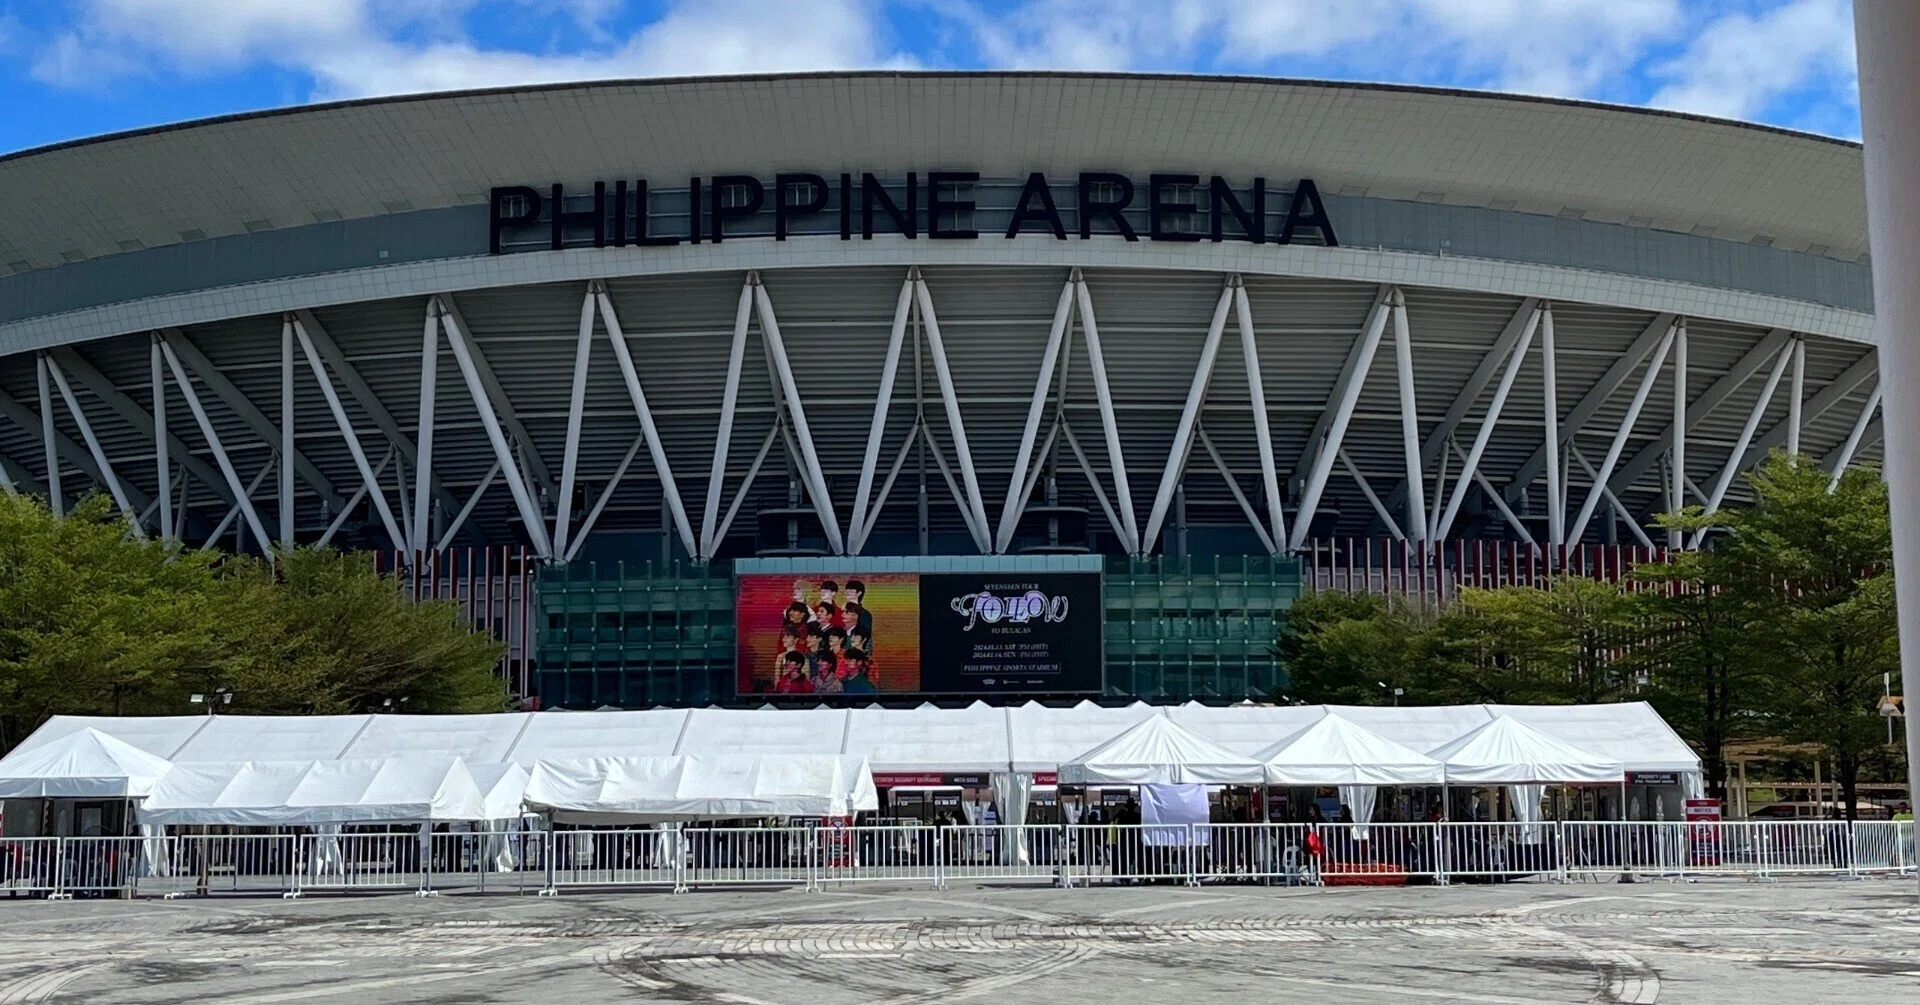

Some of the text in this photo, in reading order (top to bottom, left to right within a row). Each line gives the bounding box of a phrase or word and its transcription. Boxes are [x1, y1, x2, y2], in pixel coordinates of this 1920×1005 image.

[490, 171, 1339, 252] PHILIPPINE ARENA
[951, 590, 1069, 631] FOLLOW
